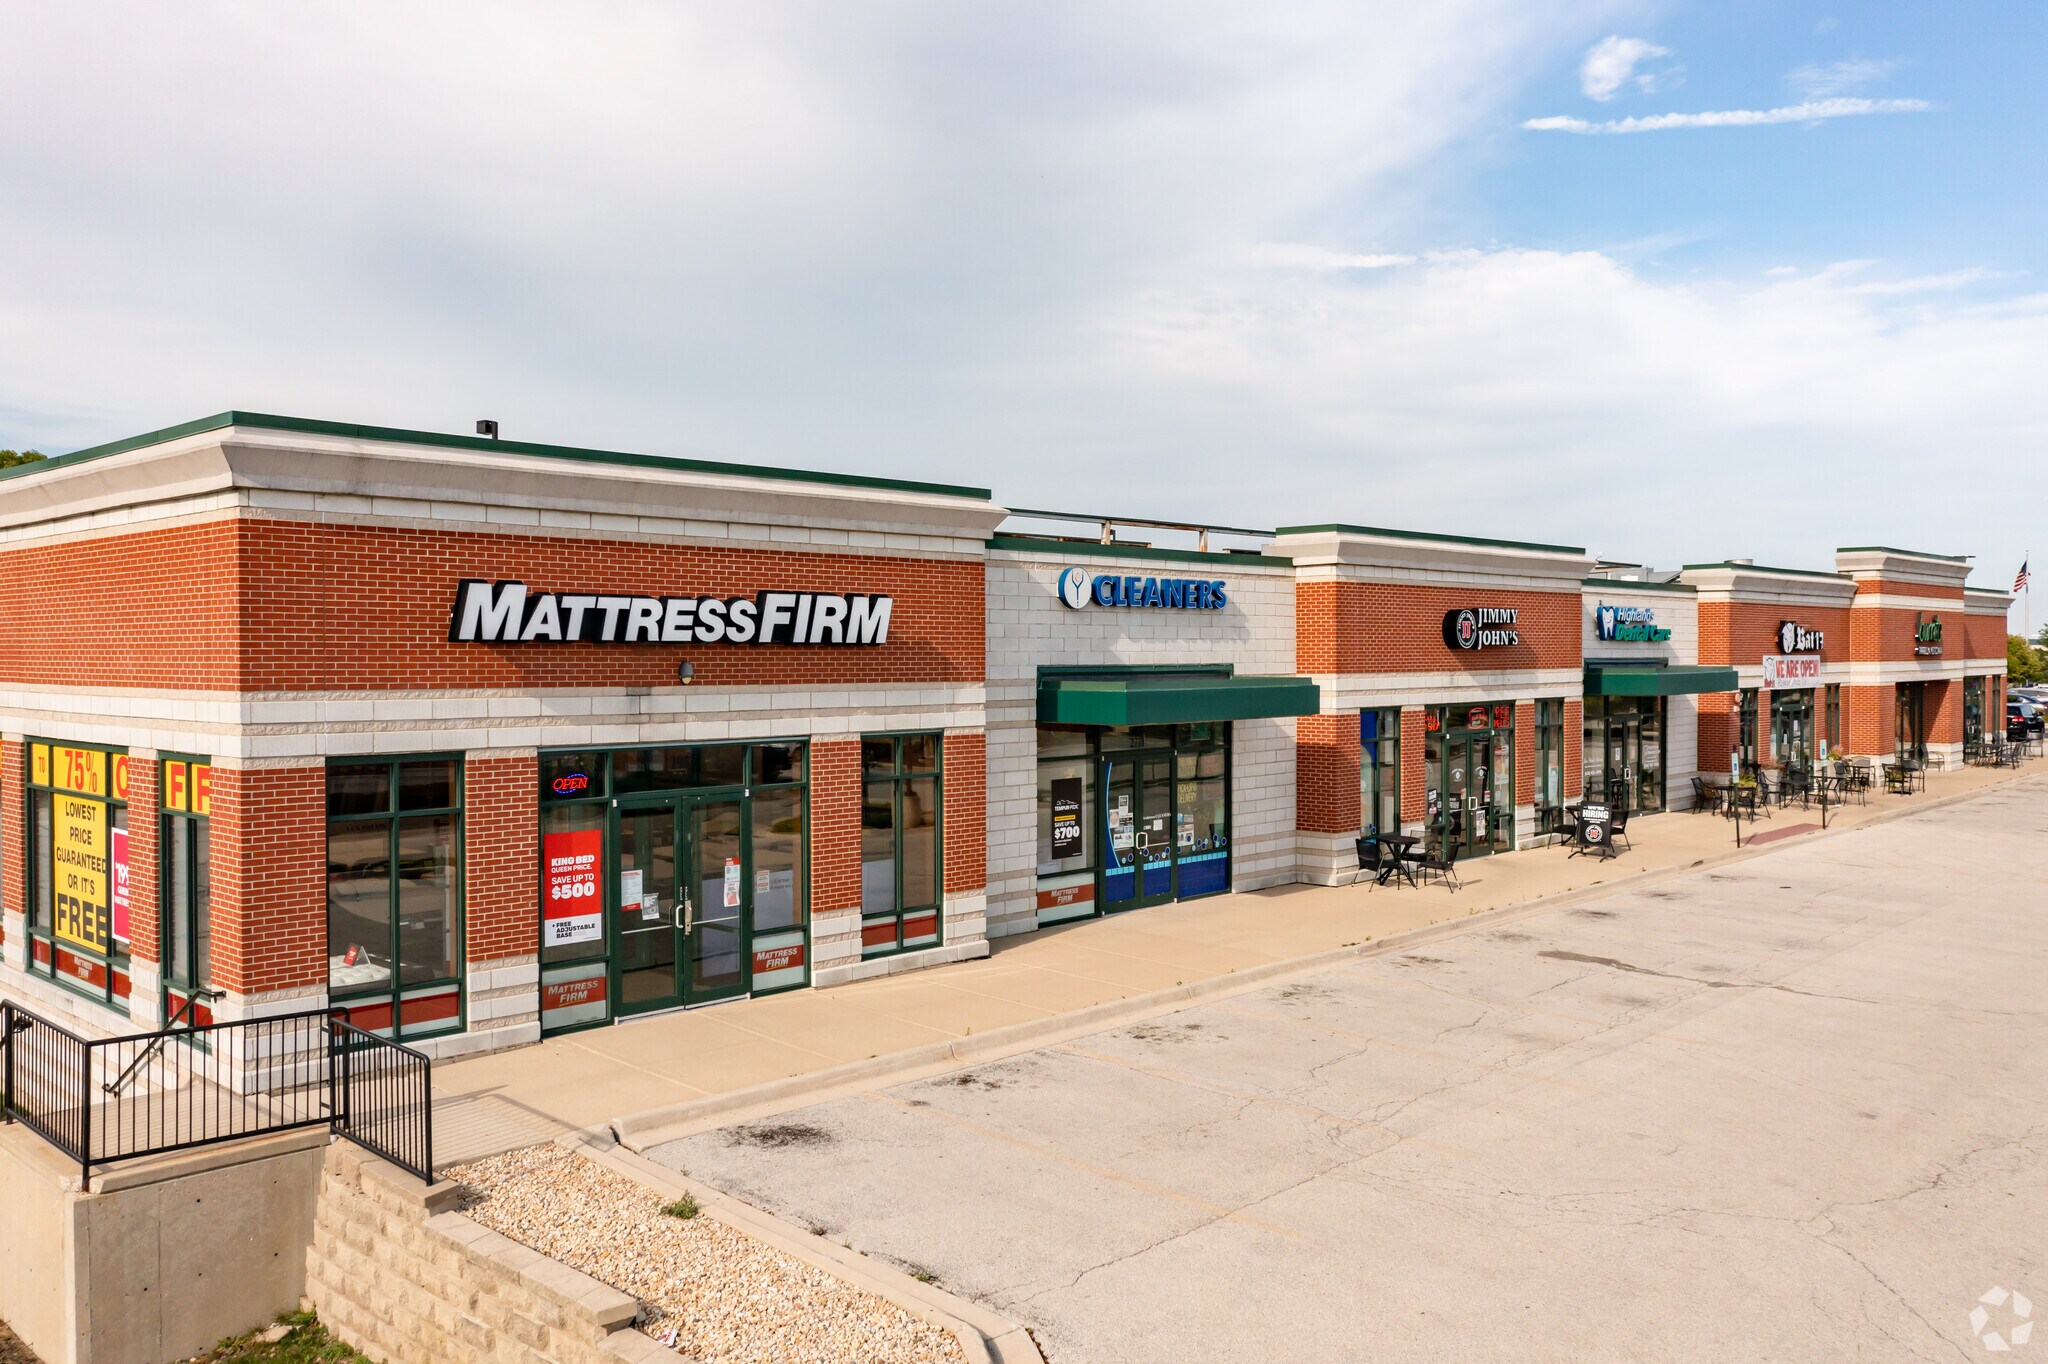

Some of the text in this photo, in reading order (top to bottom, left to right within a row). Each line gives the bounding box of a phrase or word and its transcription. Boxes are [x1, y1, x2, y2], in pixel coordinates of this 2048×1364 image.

[1092, 575, 1227, 609] CLEANERS
[1478, 608, 1518, 627] JIMMY
[1617, 607, 1654, 624] Highlands
[1616, 624, 1672, 641] Dental Care
[1478, 630, 1518, 650] JOHN'S
[1776, 660, 1784, 678] WE
[1786, 660, 1799, 678] ARE
[38, 756, 45, 773] TO
[65, 750, 98, 793] 75%
[553, 777, 588, 790] OPEN
[66, 801, 96, 821] LOWEST
[1582, 809, 1609, 819] HIRING
[70, 826, 92, 846] PRICE
[1054, 825, 1080, 839] $700
[551, 854, 595, 867] KING BED
[551, 862, 593, 874] QUEEN PRICE.
[68, 873, 95, 896] OR IT'S
[551, 872, 595, 885] SAVE UP TO
[551, 881, 595, 901] $500
[1051, 887, 1079, 898] MATTRESS
[1057, 894, 1073, 903] FIRM
[57, 892, 107, 947] FREE
[556, 923, 595, 933] ADJUSTABLE
[556, 931, 573, 939] BASE
[757, 947, 798, 961] MATTRESS
[766, 956, 789, 968] FIRM
[548, 980, 598, 995] MATTRESS
[560, 990, 588, 1003] FIRM
